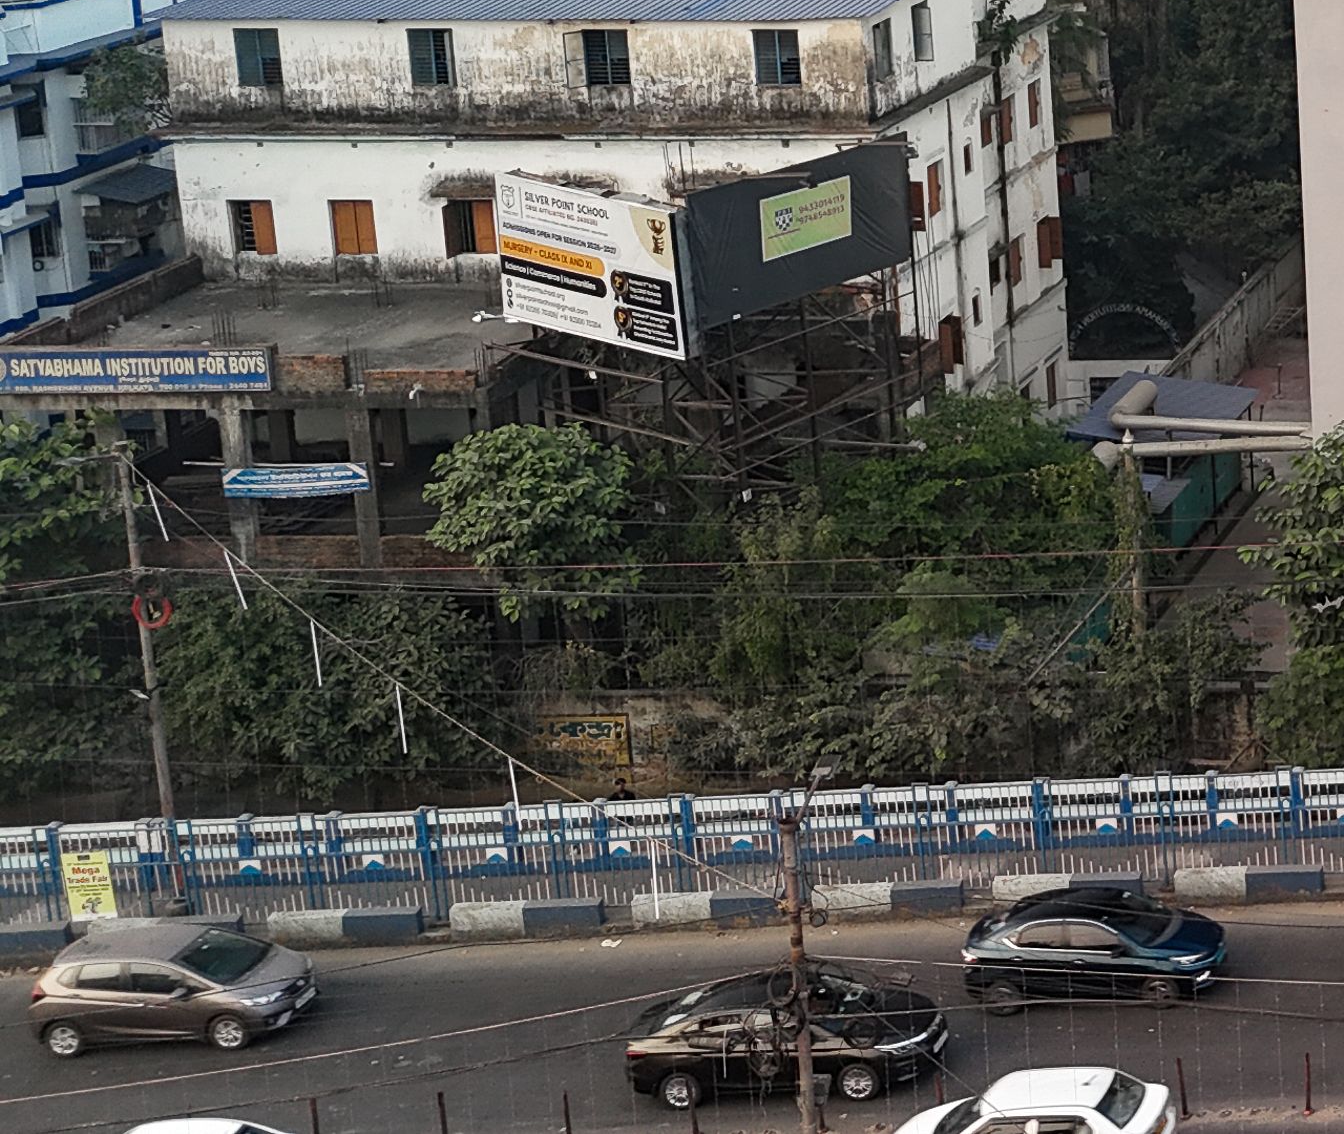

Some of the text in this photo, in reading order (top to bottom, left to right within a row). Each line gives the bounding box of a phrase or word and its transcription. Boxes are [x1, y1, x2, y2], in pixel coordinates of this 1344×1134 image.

[524, 191, 610, 220] SILVER POINT SCHOOL
[503, 240, 533, 255] NURSERY
[539, 249, 561, 263] CLASS
[561, 254, 569, 264] IX
[569, 257, 585, 268] AND
[585, 260, 593, 270] XI
[10, 356, 266, 377] SATYABHAMA INSTITUTION FOR BOYS
